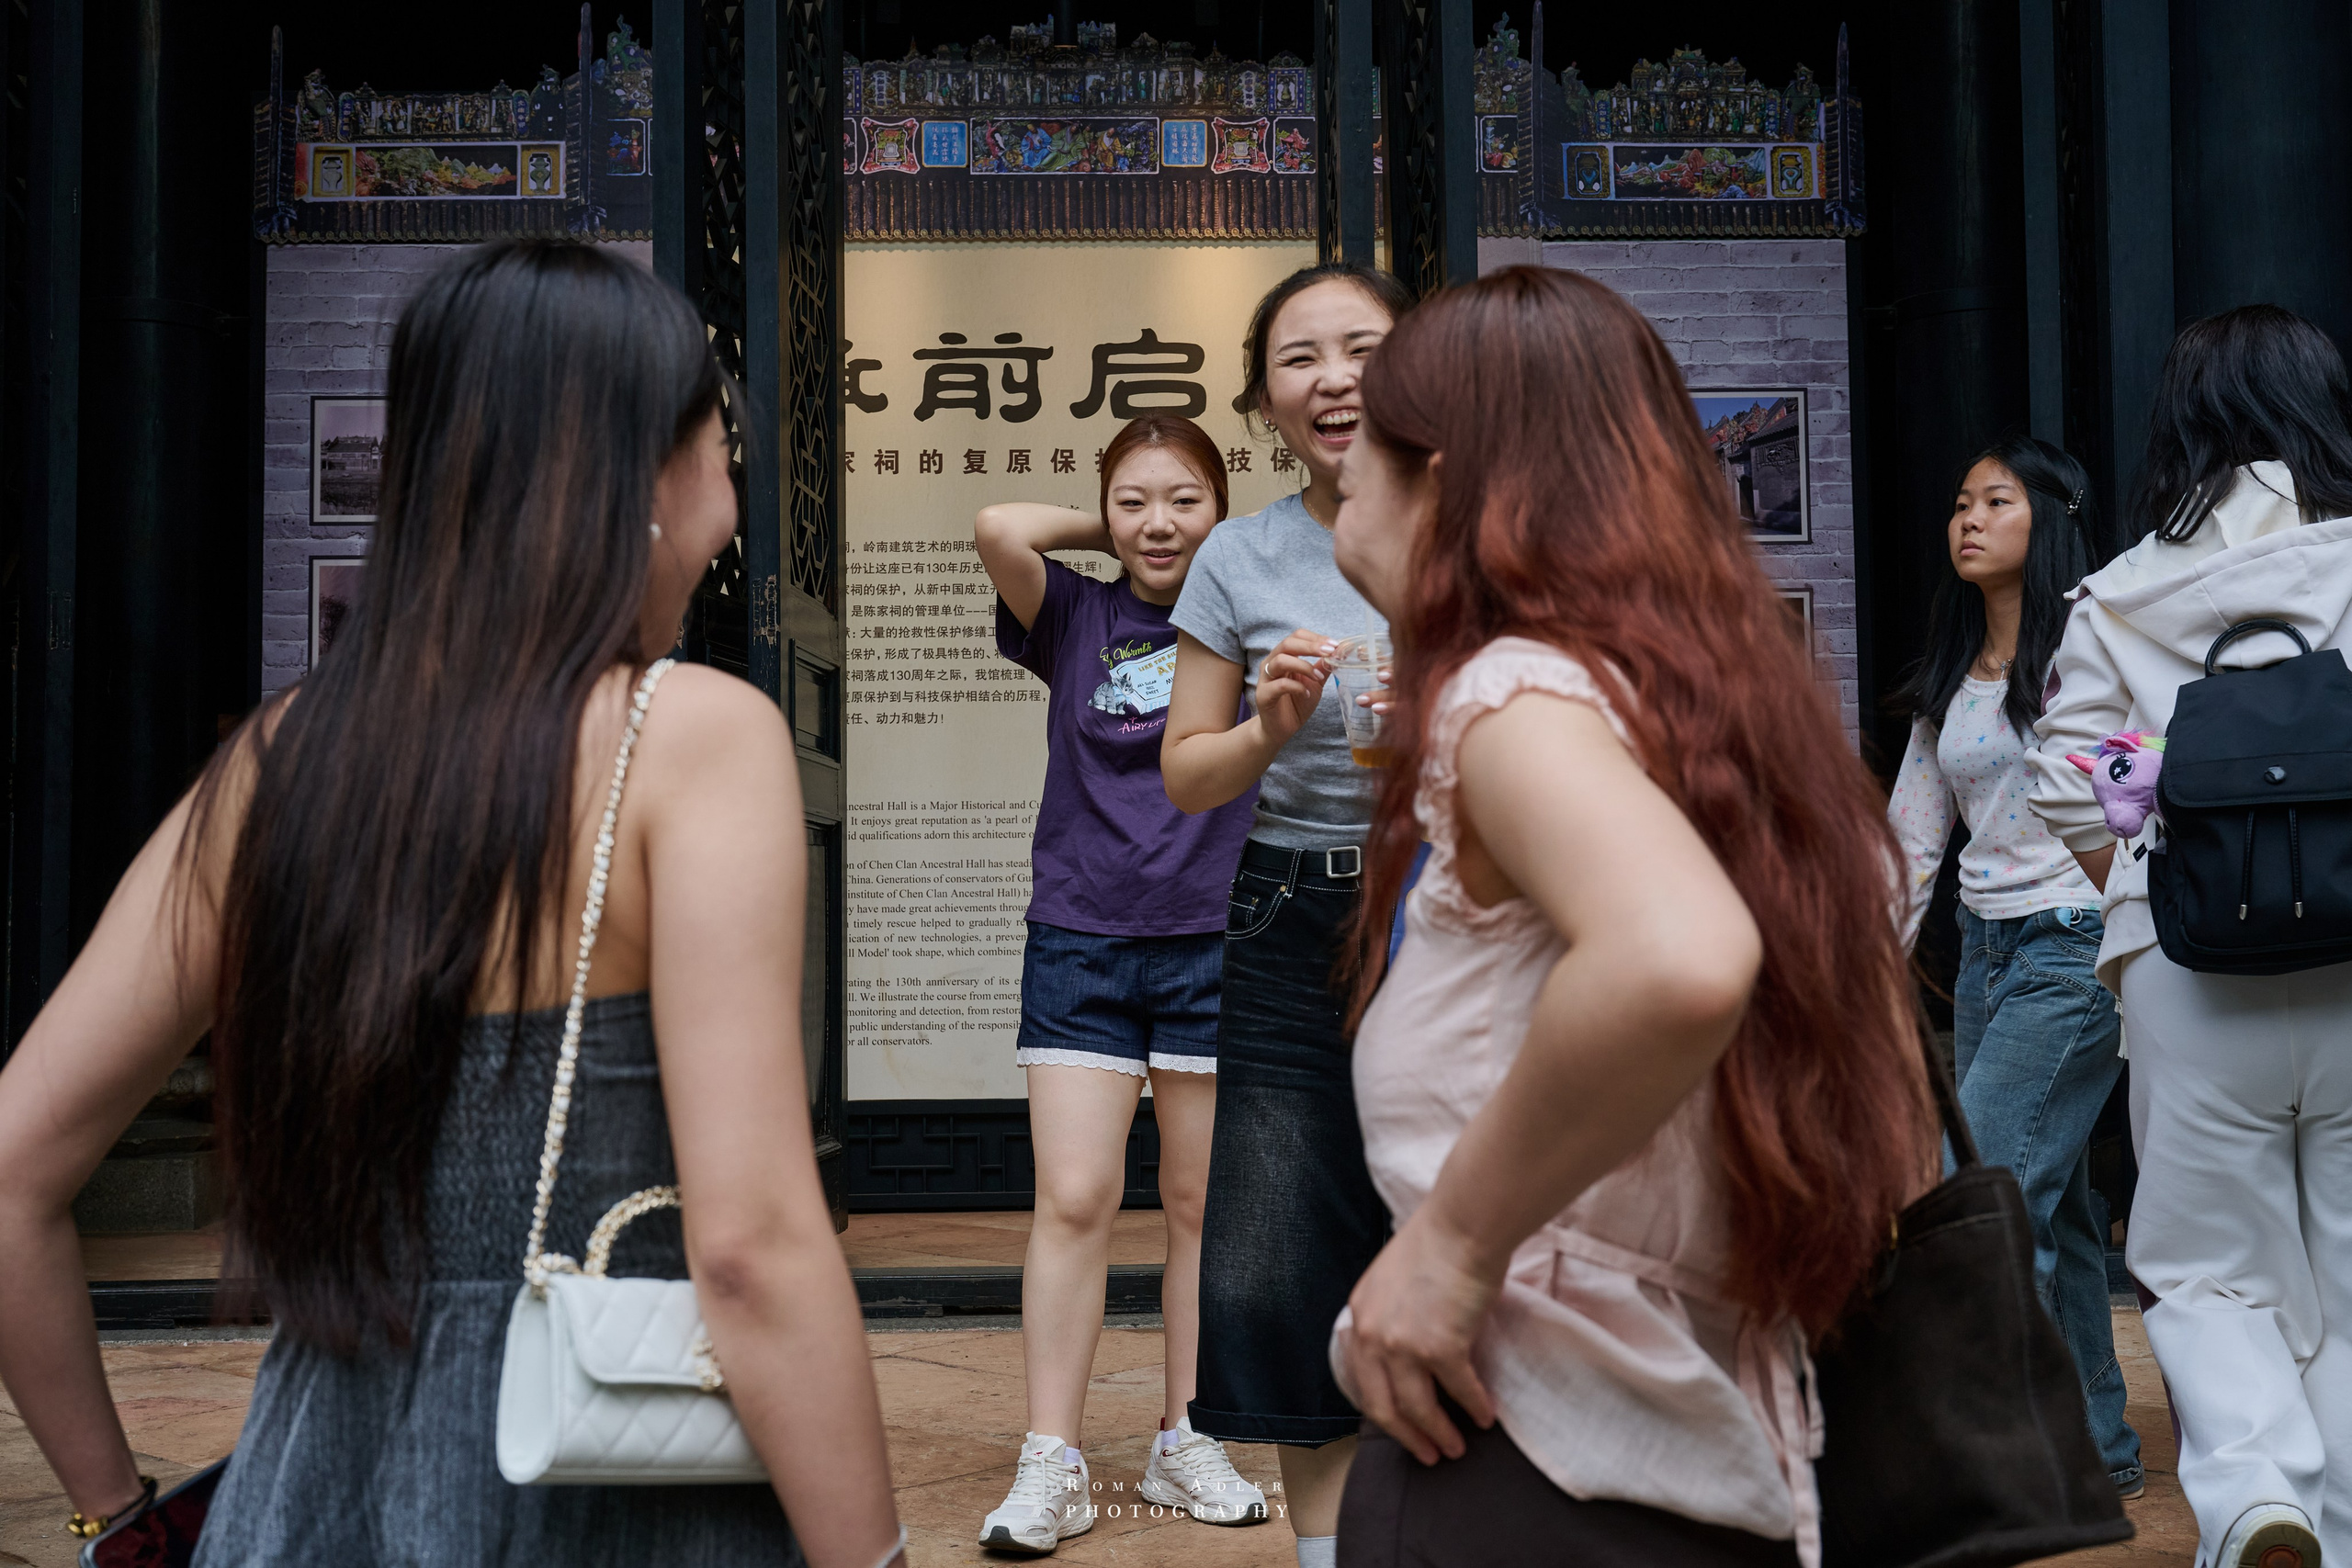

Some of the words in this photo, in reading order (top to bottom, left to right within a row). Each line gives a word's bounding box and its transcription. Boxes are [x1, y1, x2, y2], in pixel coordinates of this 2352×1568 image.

[845, 328, 1262, 422] 前启
[845, 562, 988, 575] 份让这座已有130年历史
[846, 712, 944, 725] 任、动力和魅力！
[847, 802, 883, 810] ncestral
[888, 802, 906, 810] Hall
[910, 801, 918, 810] is
[931, 801, 957, 813] Major
[962, 801, 1005, 809] Historical
[1010, 800, 1025, 809] and
[851, 817, 858, 826] It
[861, 817, 891, 828] enjoys
[895, 818, 917, 827] great
[922, 816, 967, 827] reputation
[996, 815, 1017, 826] pearl
[1022, 815, 1033, 823] of
[859, 830, 922, 842] qualifications
[924, 830, 950, 839] adorn
[954, 830, 969, 839] this
[972, 829, 1025, 839] architecture
[857, 860, 867, 869] of
[869, 860, 893, 869] Chen
[896, 860, 917, 869] Clan
[920, 860, 963, 868] Ancestral
[967, 859, 985, 868] Hall
[989, 859, 1003, 867] has
[876, 874, 931, 884] Generations
[933, 874, 944, 884] of
[945, 874, 1003, 883] conservators
[1005, 874, 1016, 882] of
[1017, 874, 1033, 882] Gu
[847, 890, 884, 899] institute
[887, 889, 898, 898] of
[899, 889, 923, 898] Chen
[926, 889, 947, 897] Clan
[951, 888, 993, 897] Ancestral
[998, 888, 1020, 898] Hall)
[846, 907, 854, 916] y
[857, 905, 878, 913] have
[882, 904, 906, 913] made
[909, 905, 932, 916] great
[934, 904, 996, 912] achievements
[854, 919, 882, 930] timely
[921, 919, 951, 930] helped
[969, 918, 1012, 929] gradually
[884, 933, 895, 942] of
[922, 932, 981, 943] technologies,
[996, 934, 1027, 943] preven
[892, 948, 912, 956] took
[915, 948, 944, 959] shape,
[947, 947, 975, 956] which
[978, 947, 1021, 955] combines
[847, 977, 871, 988] ating
[876, 977, 890, 987] the
[897, 977, 921, 987] 130th
[926, 977, 979, 988] anniversary
[984, 976, 995, 985] of
[1000, 976, 1010, 985] its
[860, 993, 876, 1001] We
[878, 992, 918, 1001] illustrate
[921, 992, 934, 1000] the
[969, 991, 990, 1000] from
[847, 1007, 897, 1018] monitoring
[900, 1007, 916, 1015] and
[920, 1007, 964, 1016] detection,
[967, 1006, 989, 1015] from
[850, 1022, 877, 1033] public
[881, 1021, 945, 1032] understanding
[949, 1021, 959, 1030] of
[961, 1021, 975, 1030] the
[857, 1037, 868, 1045] all
[872, 1036, 932, 1045] conservators.
